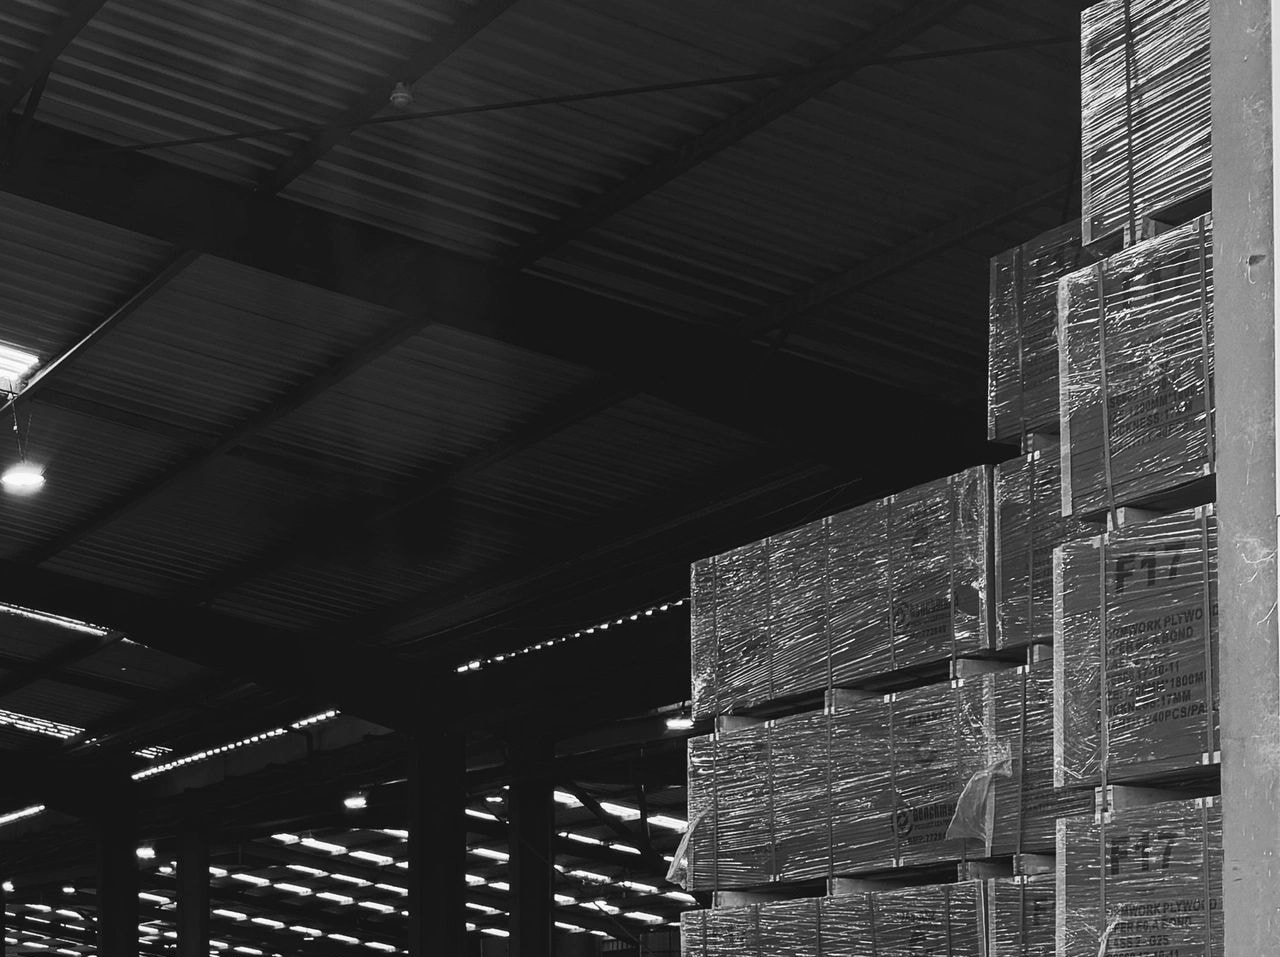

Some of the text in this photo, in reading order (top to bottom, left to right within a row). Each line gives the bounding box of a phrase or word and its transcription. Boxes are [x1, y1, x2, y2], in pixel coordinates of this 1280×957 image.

[1116, 543, 1186, 593] F17
[1163, 603, 1218, 627] PLYWOD
[1111, 832, 1178, 875] F17
[1162, 898, 1218, 914] PLYWOD
